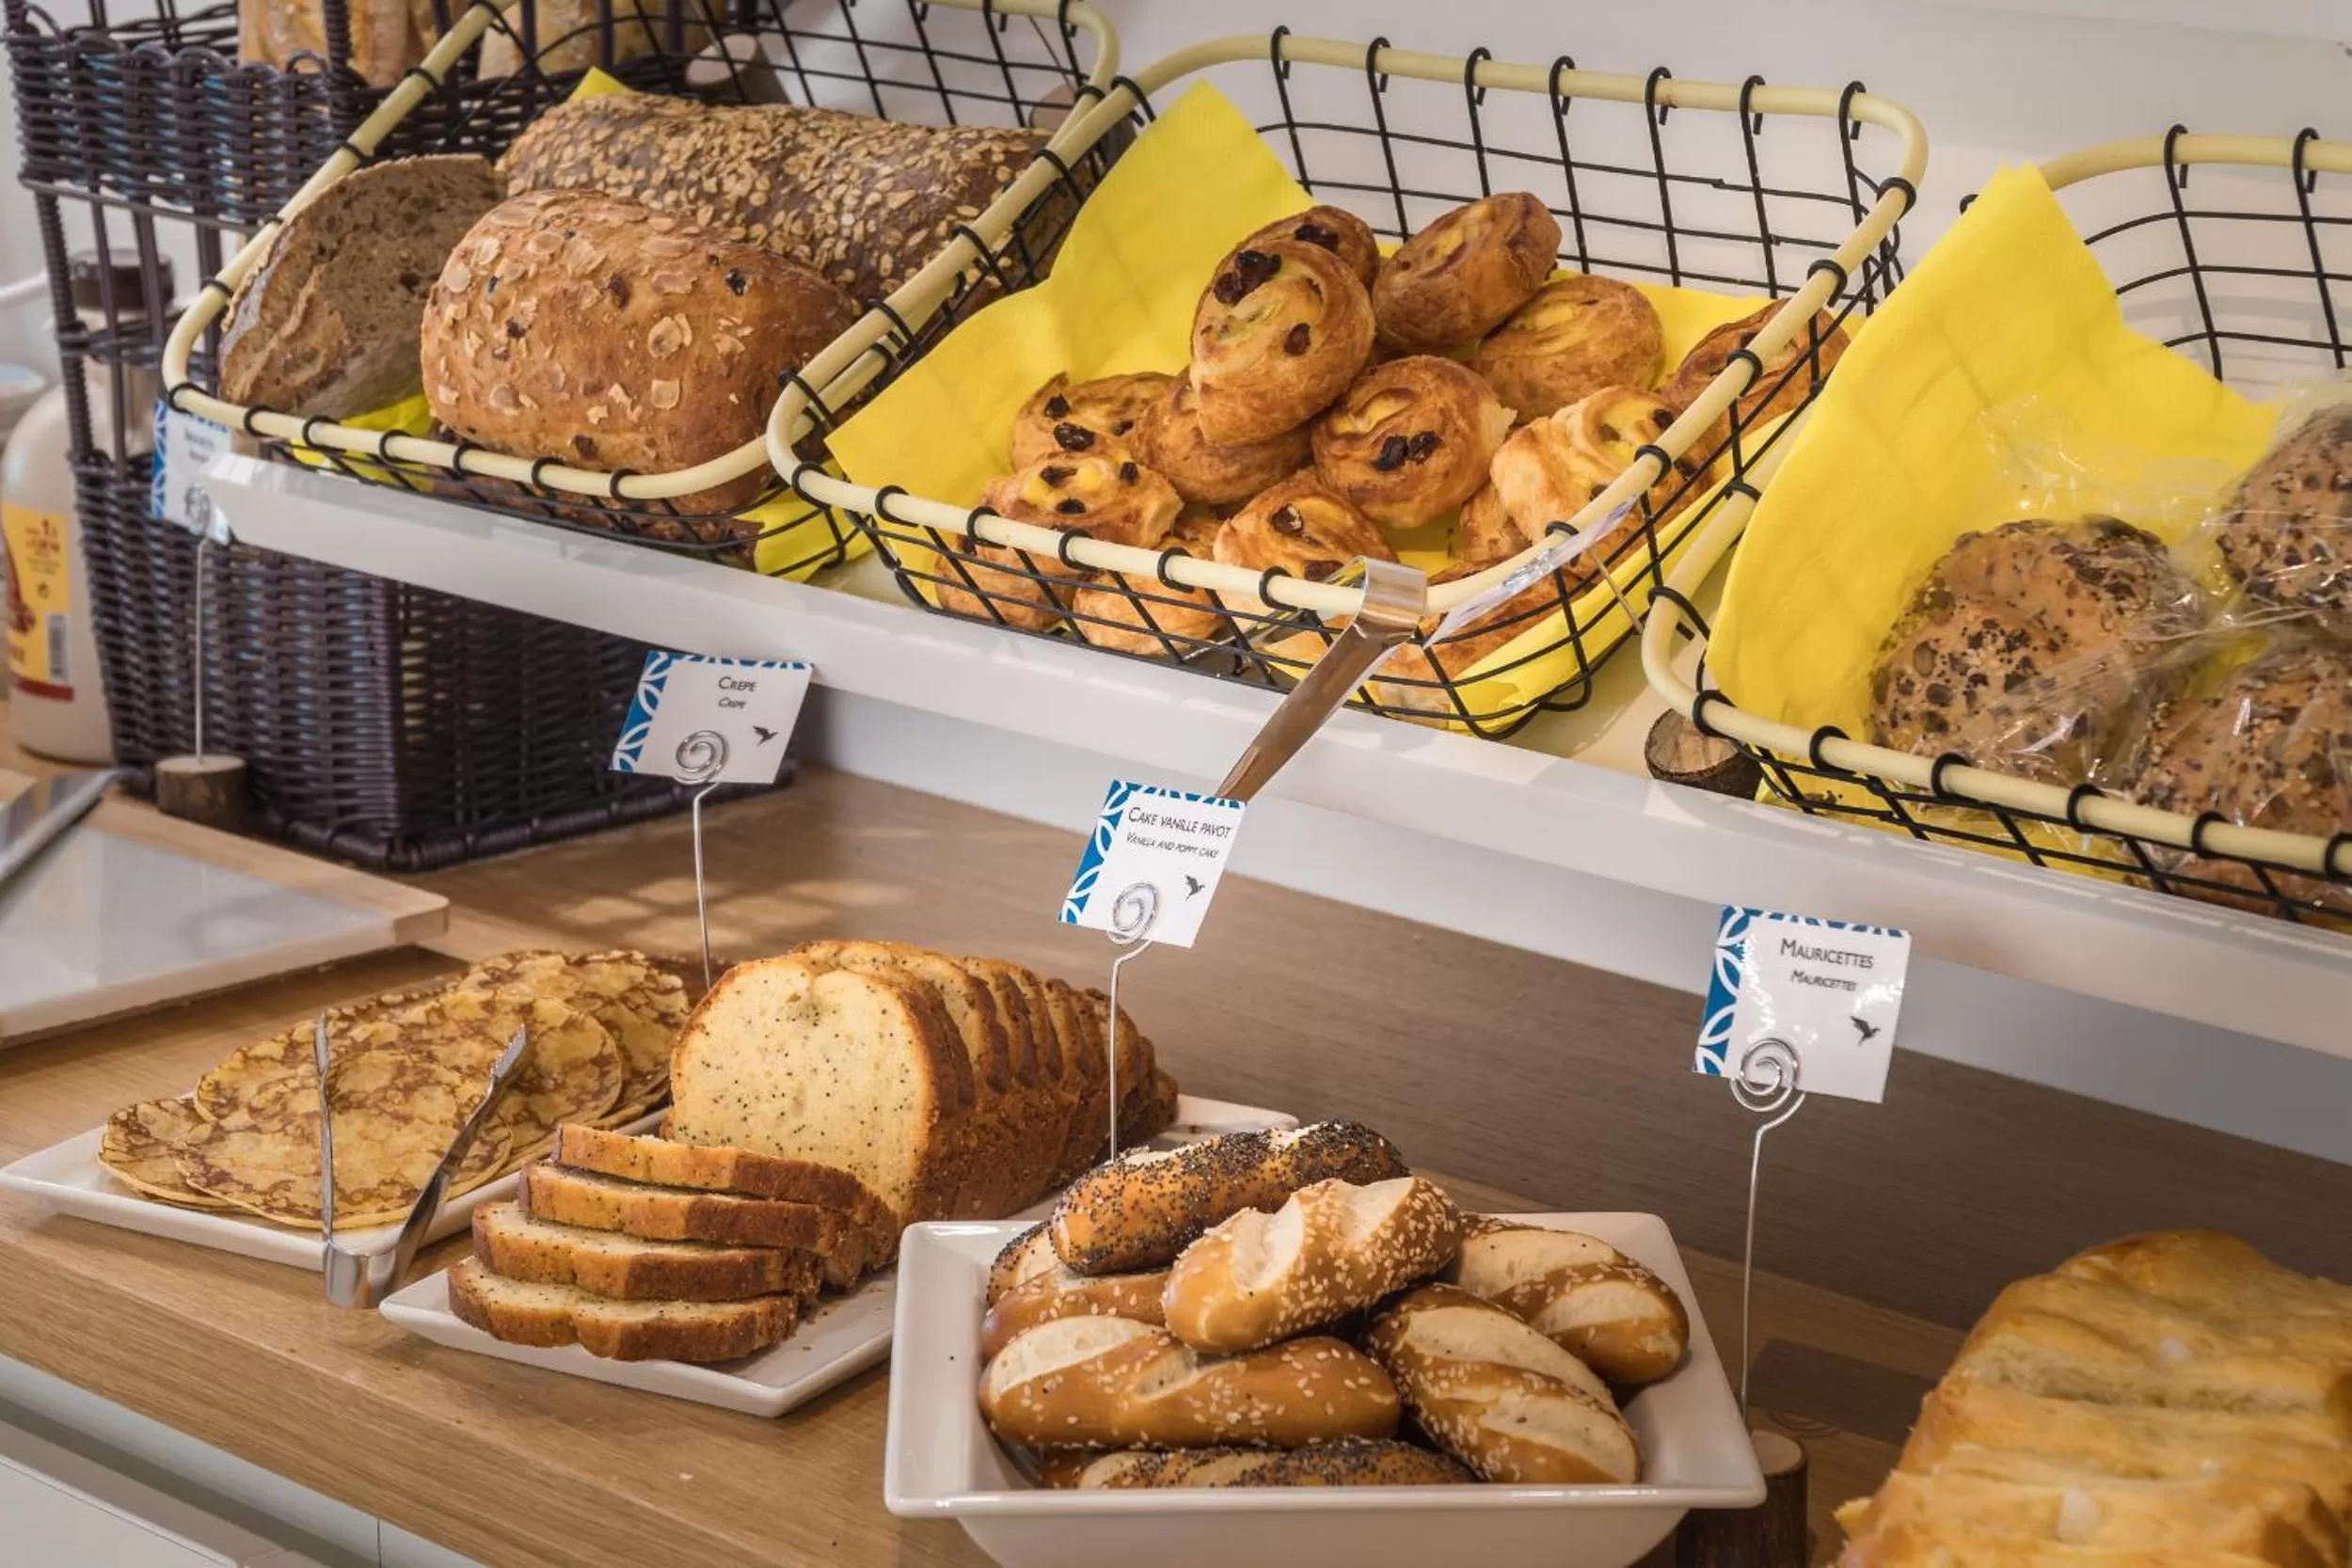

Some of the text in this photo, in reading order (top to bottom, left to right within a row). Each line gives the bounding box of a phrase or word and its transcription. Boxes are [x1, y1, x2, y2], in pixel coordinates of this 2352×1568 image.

[1129, 807, 1232, 838] CAKE VANILLE PAVOT
[1780, 938, 1874, 969] MAURICETTES
